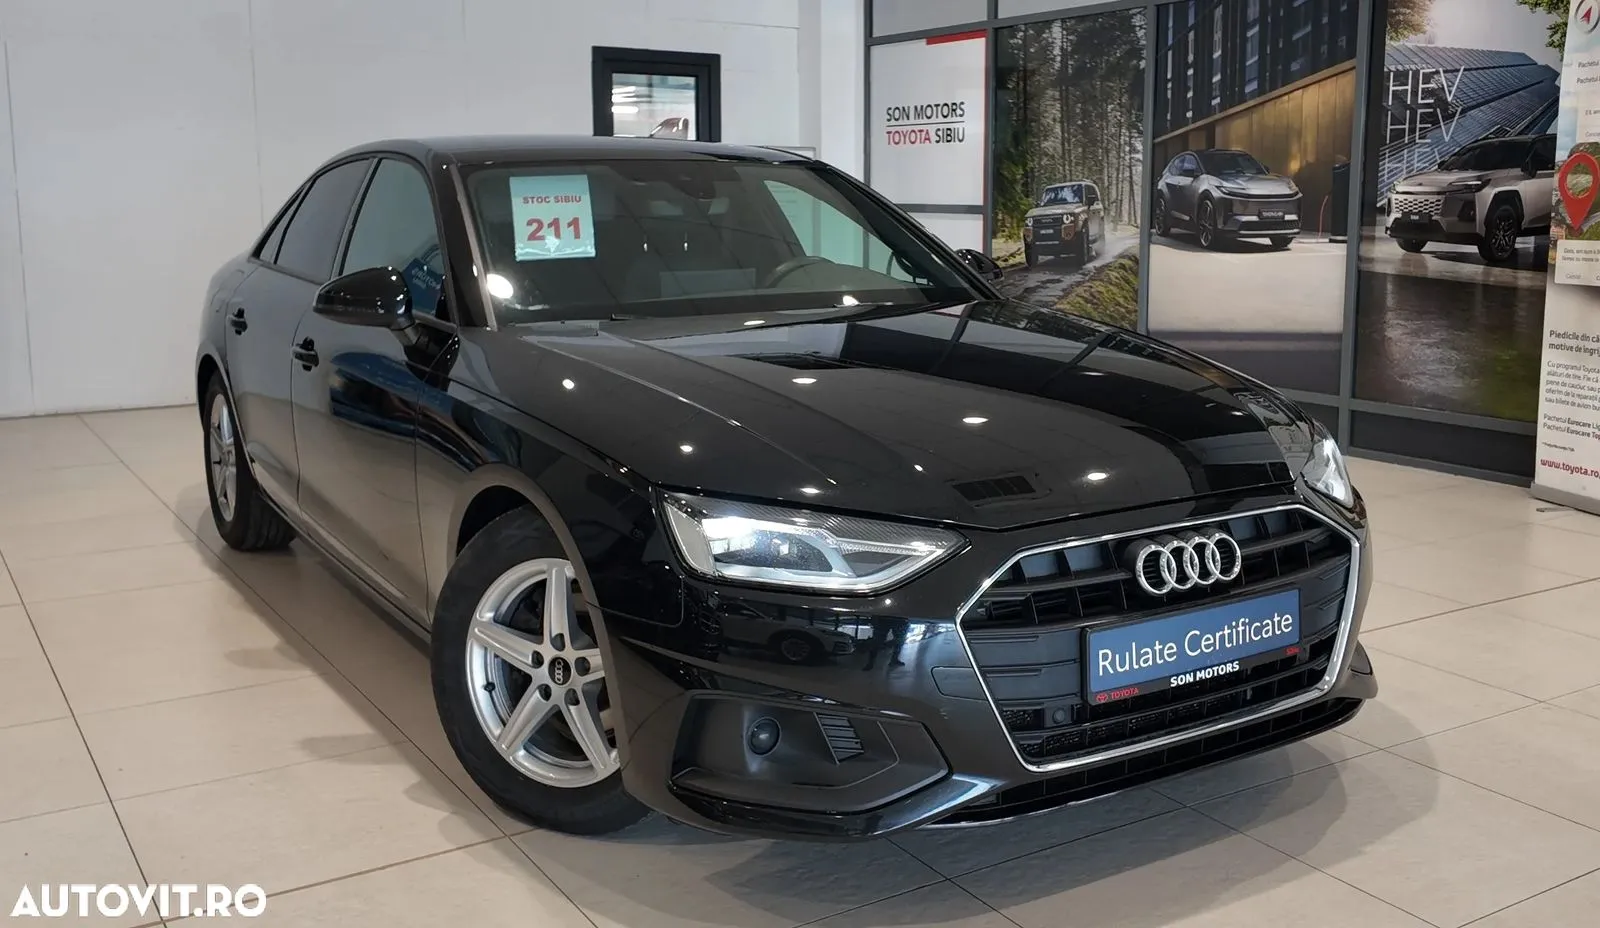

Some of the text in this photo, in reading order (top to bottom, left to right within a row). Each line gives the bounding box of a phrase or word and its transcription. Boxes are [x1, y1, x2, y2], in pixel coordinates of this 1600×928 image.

[1388, 66, 1464, 105] HEV
[886, 101, 965, 122] SON MOTORS
[886, 127, 965, 145] TOYOTA SIBIU
[1387, 107, 1461, 144] HEV
[522, 195, 582, 205] STOC SIBIU
[526, 217, 581, 241] 211
[1549, 329, 1579, 341] Piedicile
[1580, 333, 1590, 342] din
[1548, 342, 1574, 352] motive
[1574, 345, 1582, 353] de
[1566, 426, 1590, 438] Eurocare
[1540, 458, 1600, 480] www.toyota.ro
[1098, 612, 1293, 677] Rulate Certificate
[1170, 660, 1239, 687] SON MOTORS
[1111, 687, 1139, 700] TOYOTA
